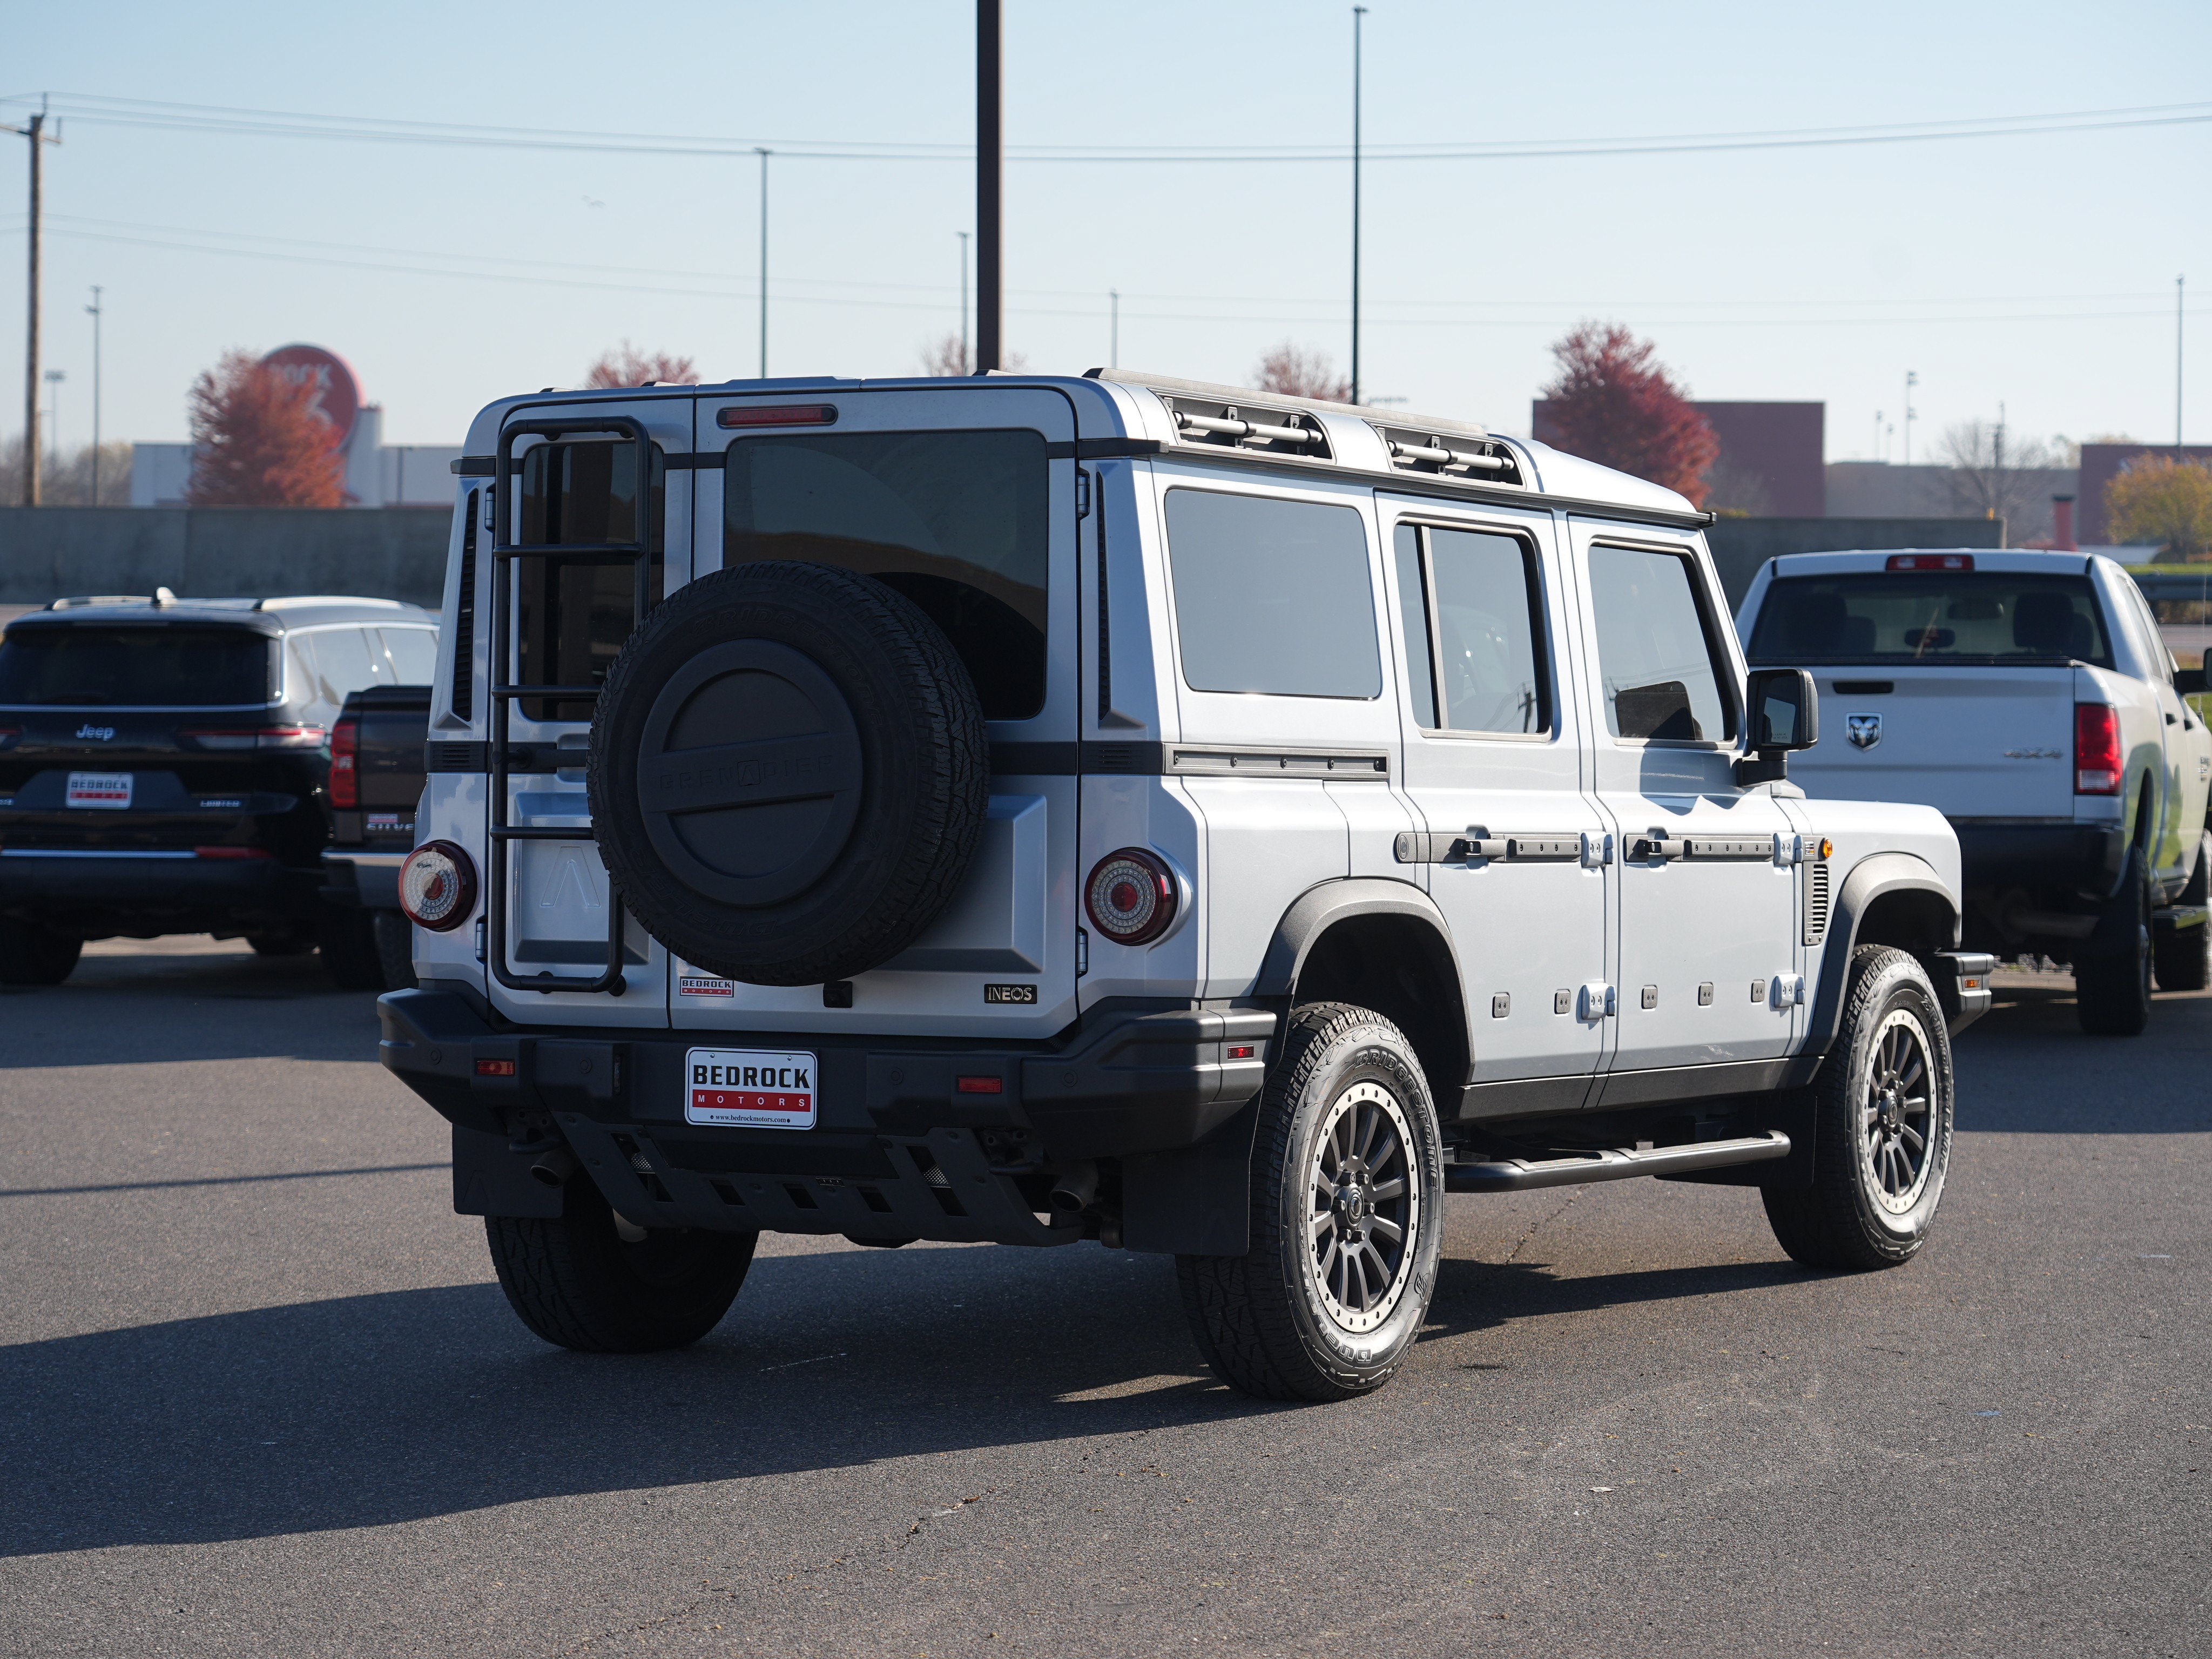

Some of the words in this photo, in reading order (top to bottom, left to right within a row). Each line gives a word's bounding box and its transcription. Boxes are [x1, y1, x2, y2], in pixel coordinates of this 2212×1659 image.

[691, 607, 884, 727] BRIDGESTONE
[76, 724, 114, 741] Jeep
[71, 779, 127, 789] BEDROCK
[682, 980, 732, 988] BEDROCK
[988, 987, 1032, 1001] INEOS
[693, 1065, 811, 1089] BEDROCK
[698, 1094, 805, 1107] MOTORS
[715, 1114, 787, 1124] www.bedrockmotors.com
[1353, 1049, 1439, 1190] BRIDGESTONE
[1300, 1259, 1372, 1364] DUELER
